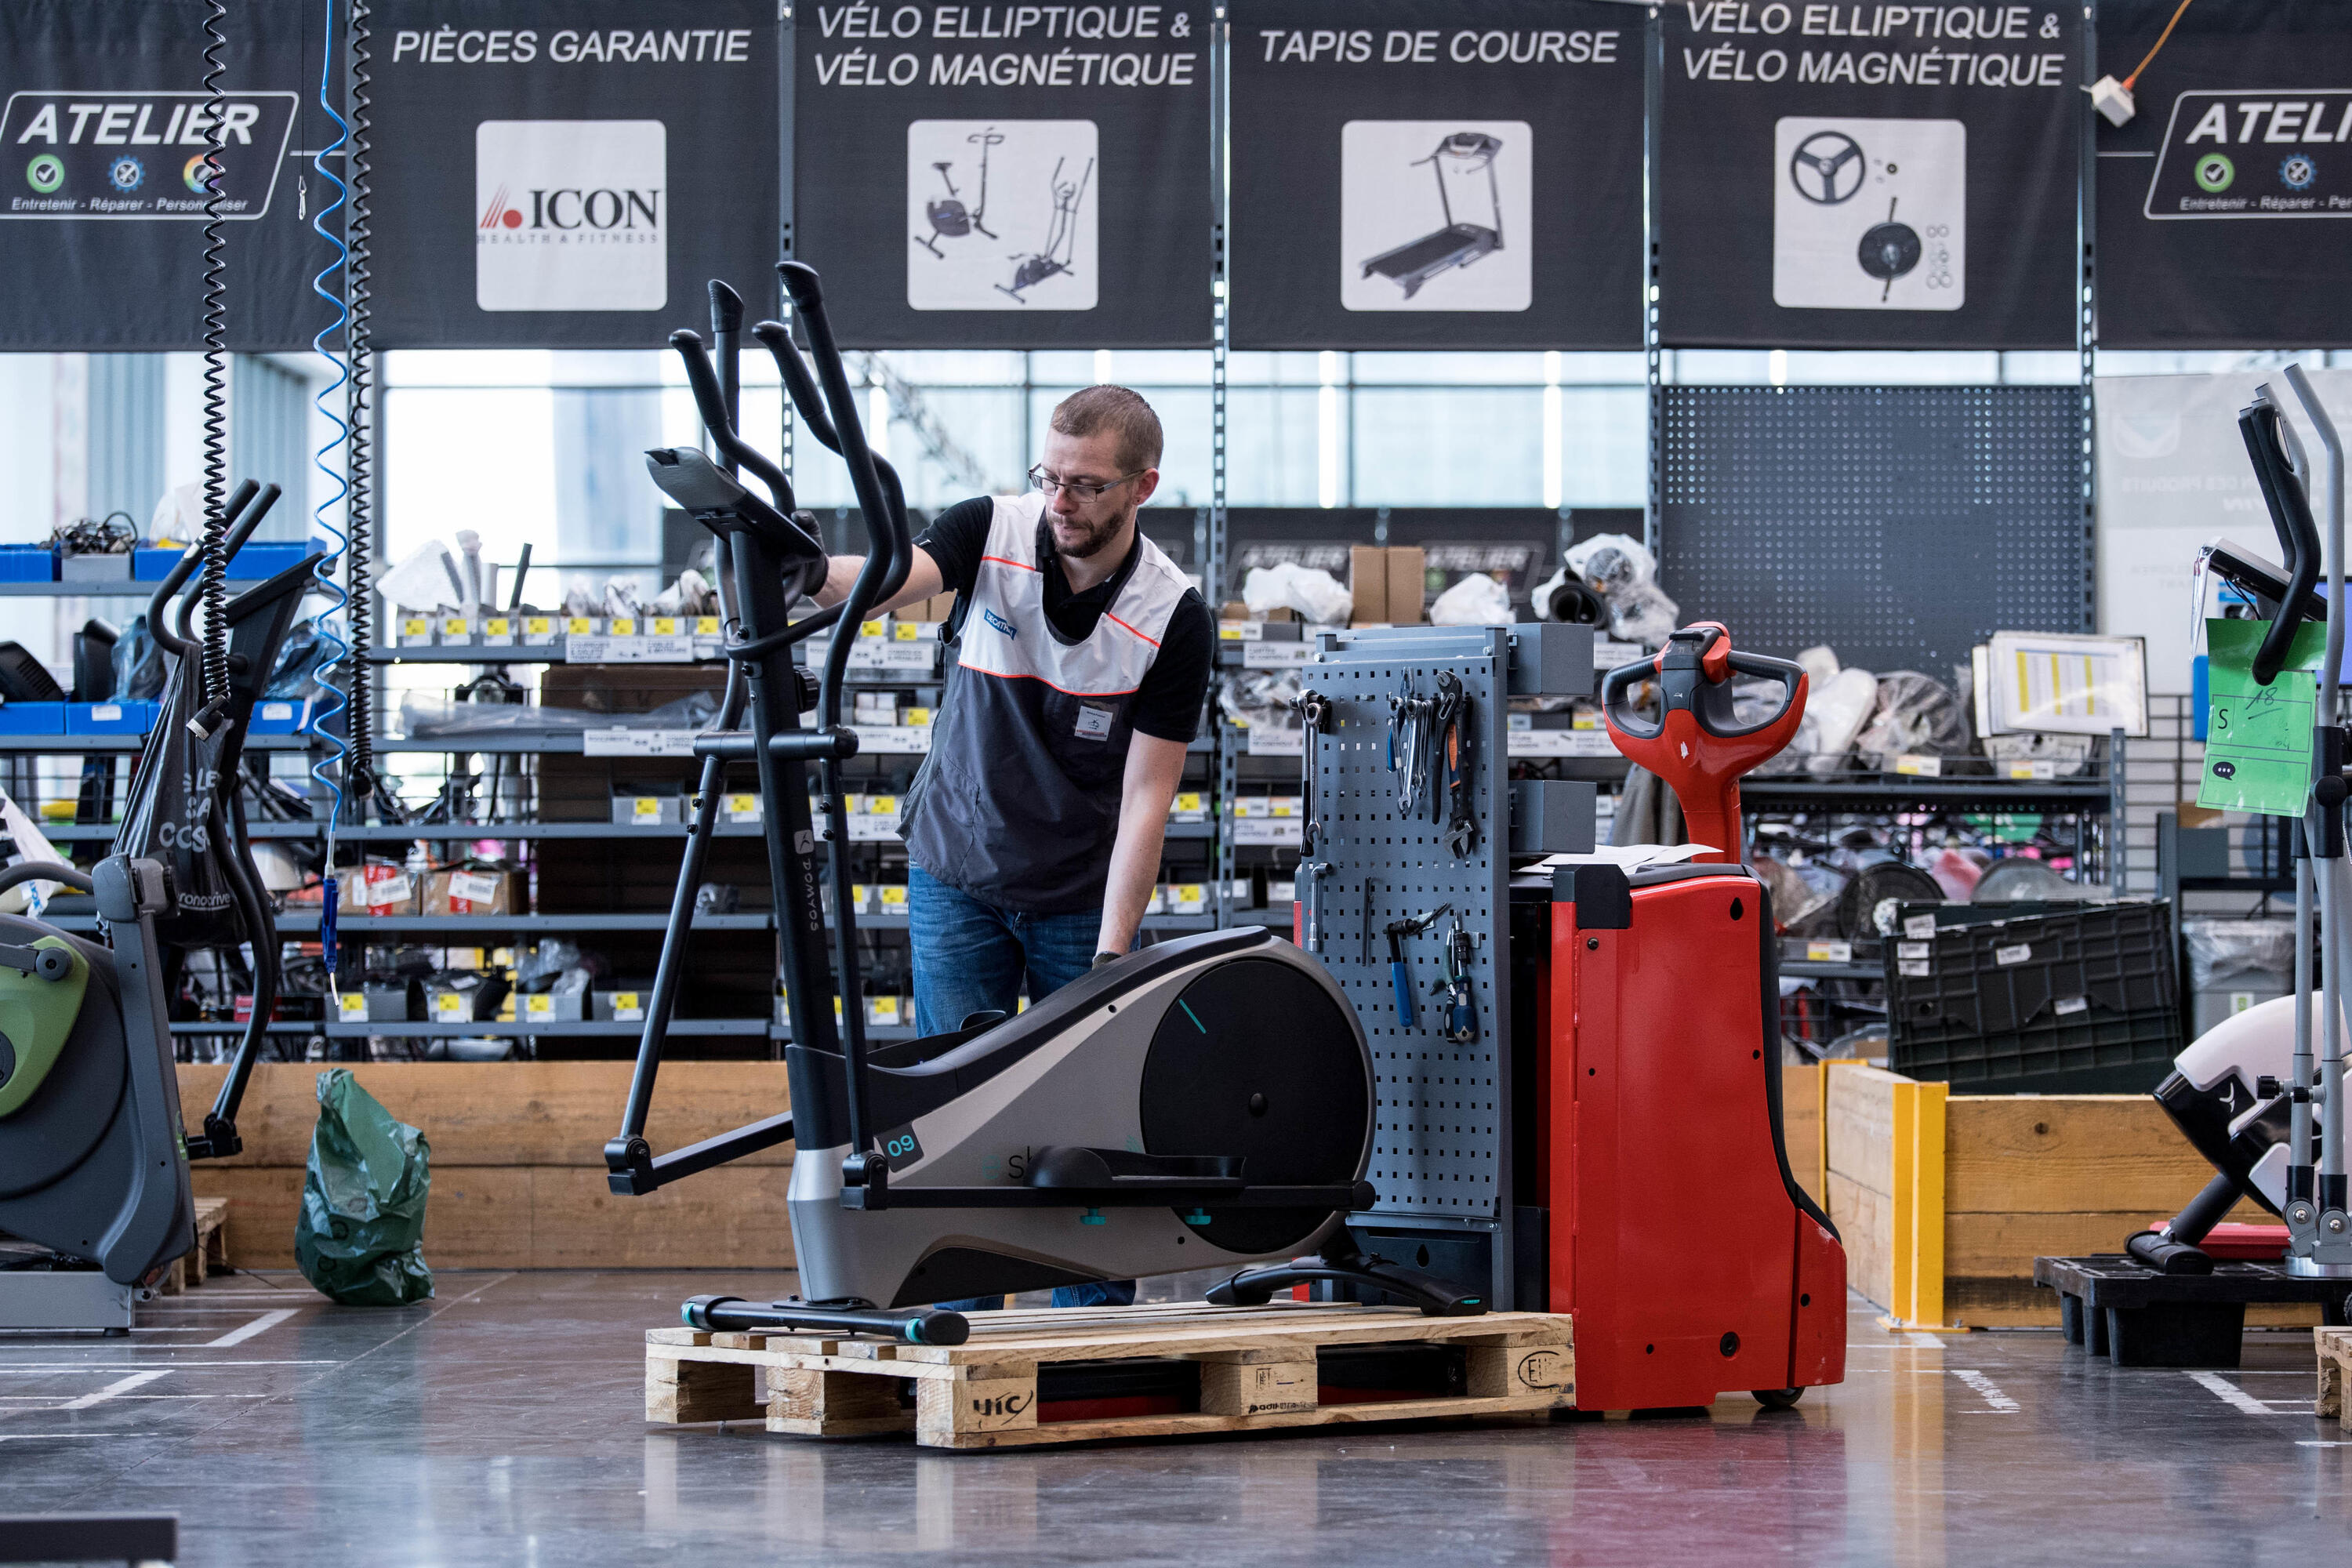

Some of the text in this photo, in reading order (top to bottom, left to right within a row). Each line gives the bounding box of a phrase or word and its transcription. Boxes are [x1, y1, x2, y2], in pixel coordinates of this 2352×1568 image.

[817, 0, 1191, 40] VÉLO ELLIPTIQUE &
[1802, 3, 2031, 40] ELLIPTIQUE
[2038, 12, 2060, 40] &
[392, 23, 753, 64] PIÈCES GARANTIE
[1259, 30, 1621, 64] TAPIS DE COURSE
[814, 46, 1197, 87] VÉLO MAGNÉTIQUE
[1682, 42, 2067, 88] VÉLO MAGNÉTIQUE
[16, 103, 260, 144] ATELIER
[2185, 102, 2352, 144] ATELI
[12, 197, 78, 211] Entretenir
[89, 197, 144, 213] Réparer
[156, 197, 249, 212] Personaliser
[528, 187, 662, 230] ICON
[2180, 196, 2248, 211] Entretenir
[2260, 195, 2318, 212] Réparer
[477, 234, 550, 245] HEALTH
[577, 233, 658, 244] FITNESS
[2217, 708, 2229, 730] S
[802, 858, 819, 931] DOMYOS
[887, 1134, 915, 1158] 09
